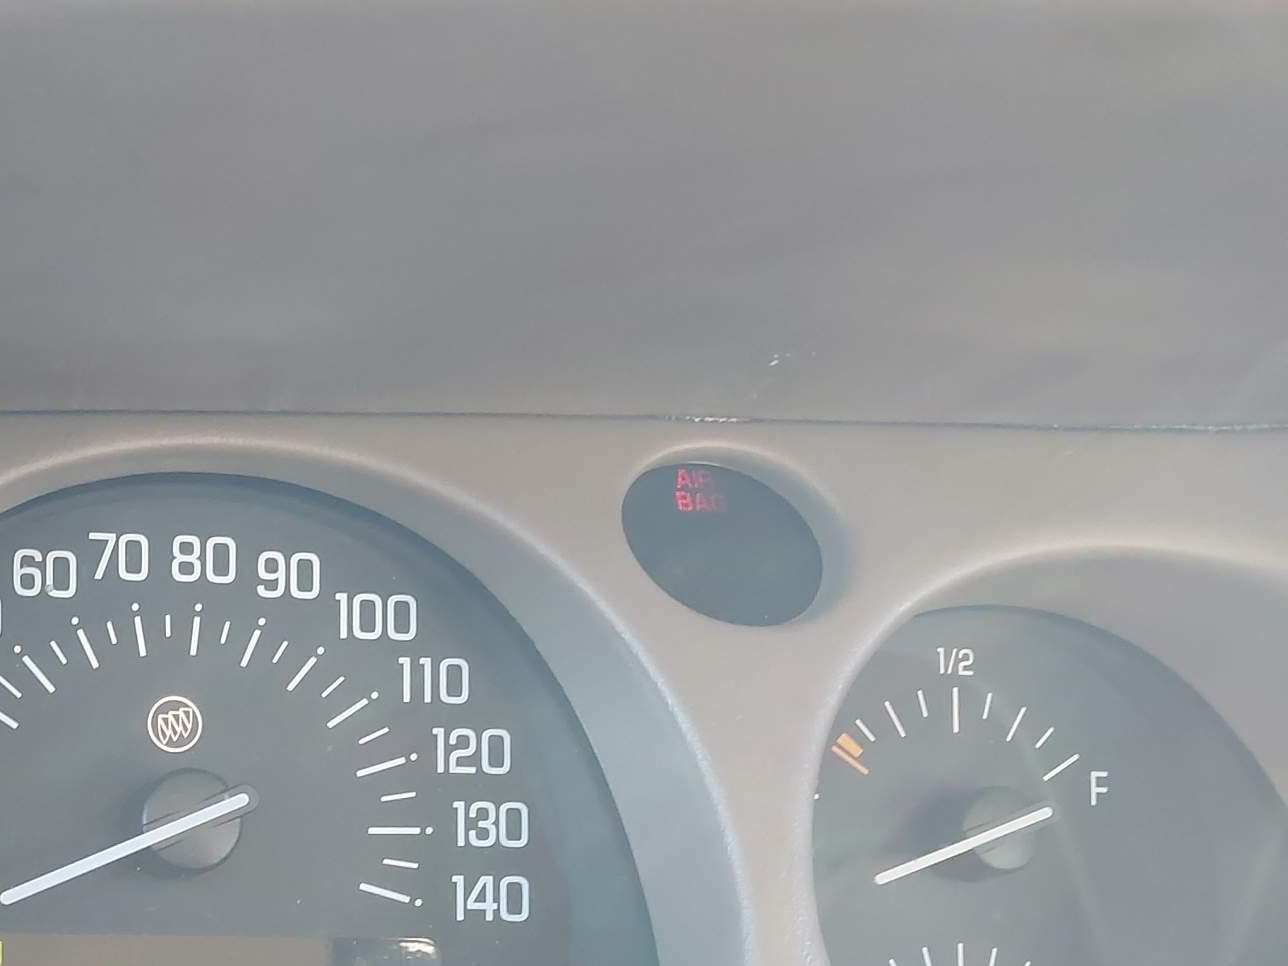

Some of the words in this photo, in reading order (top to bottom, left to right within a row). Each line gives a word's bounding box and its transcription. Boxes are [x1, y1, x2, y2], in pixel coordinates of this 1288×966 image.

[13, 548, 77, 599] 60
[88, 532, 149, 582] 70
[171, 534, 237, 584] 80
[256, 550, 321, 600] 90
[335, 592, 417, 641] 100
[398, 656, 469, 705] 110
[936, 647, 974, 676] 1/2
[431, 727, 511, 775] 120
[1090, 770, 1109, 806] F
[452, 800, 529, 848] 130
[451, 875, 530, 922] 140
